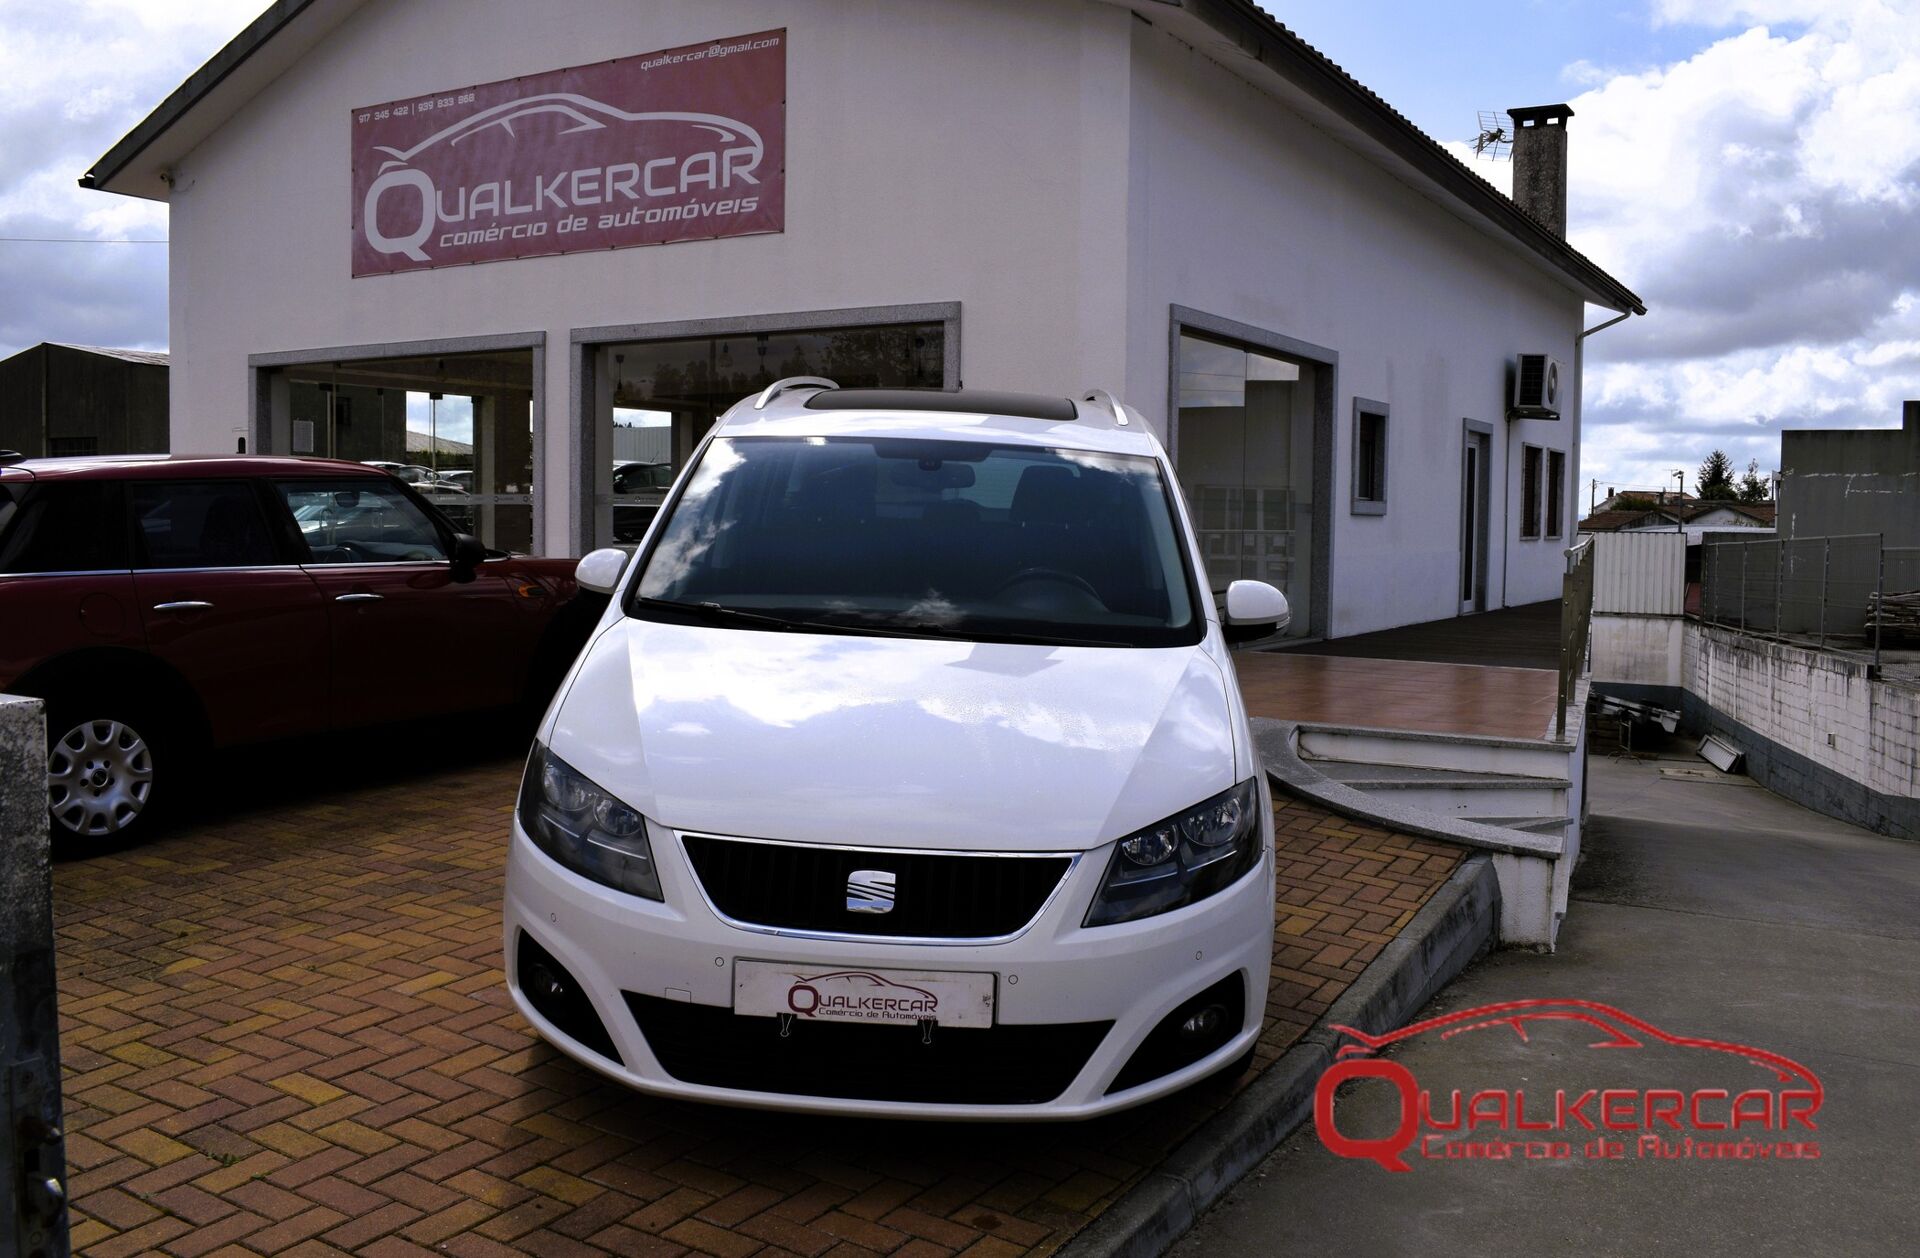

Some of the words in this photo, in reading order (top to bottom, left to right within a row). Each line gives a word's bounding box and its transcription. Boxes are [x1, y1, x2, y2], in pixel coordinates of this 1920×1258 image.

[640, 37, 780, 71] qualkercar@gmail.com
[358, 113, 371, 124] 917
[374, 109, 390, 121] 345
[393, 105, 409, 116] 422
[418, 100, 434, 112] 939
[364, 146, 764, 261] QUALKERCAR
[440, 217, 548, 247] comércio
[557, 214, 588, 233] de
[598, 196, 759, 230] automóveis
[788, 985, 938, 1018] QUALKERCAR
[818, 1007, 863, 1018] Comércio
[867, 1010, 879, 1018] de
